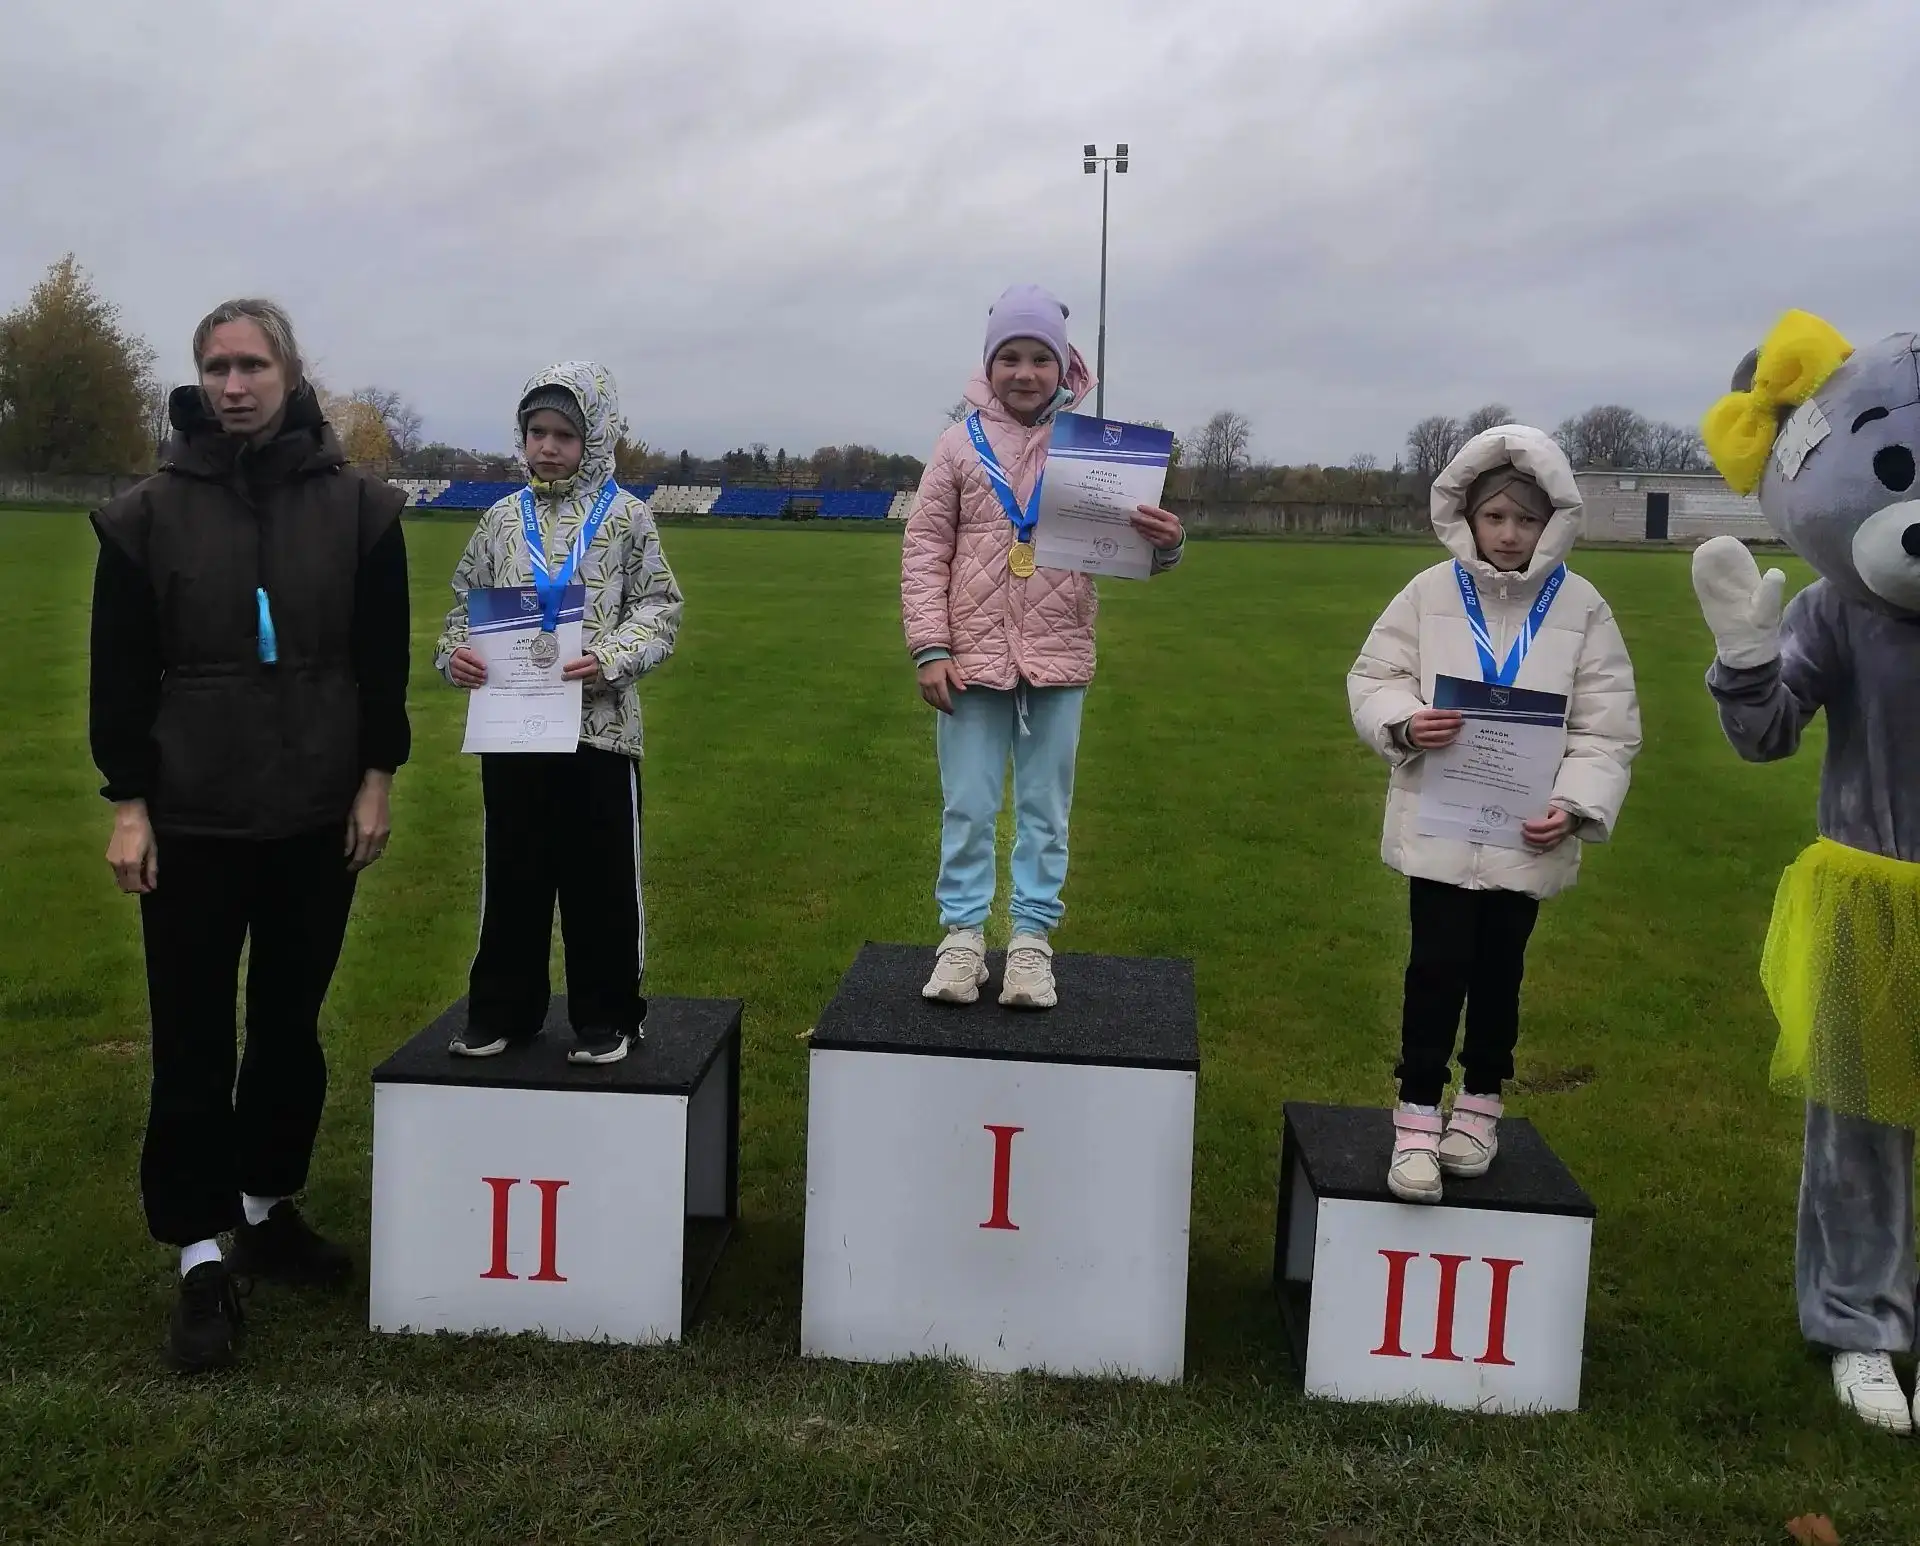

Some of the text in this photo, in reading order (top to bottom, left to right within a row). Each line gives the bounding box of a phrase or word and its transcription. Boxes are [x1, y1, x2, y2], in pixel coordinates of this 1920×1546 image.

[969, 416, 981, 438] СПОРТ
[1091, 468, 1118, 479] ДИПЛОМ
[523, 499, 534, 524] СПОРТ
[589, 499, 607, 525] СПОРТ
[1536, 585, 1555, 613] СПОРТ
[1479, 727, 1509, 739] ДИПЛОМ
[979, 1124, 1024, 1231] I
[480, 1177, 569, 1283] II
[1369, 1249, 1524, 1366] III
